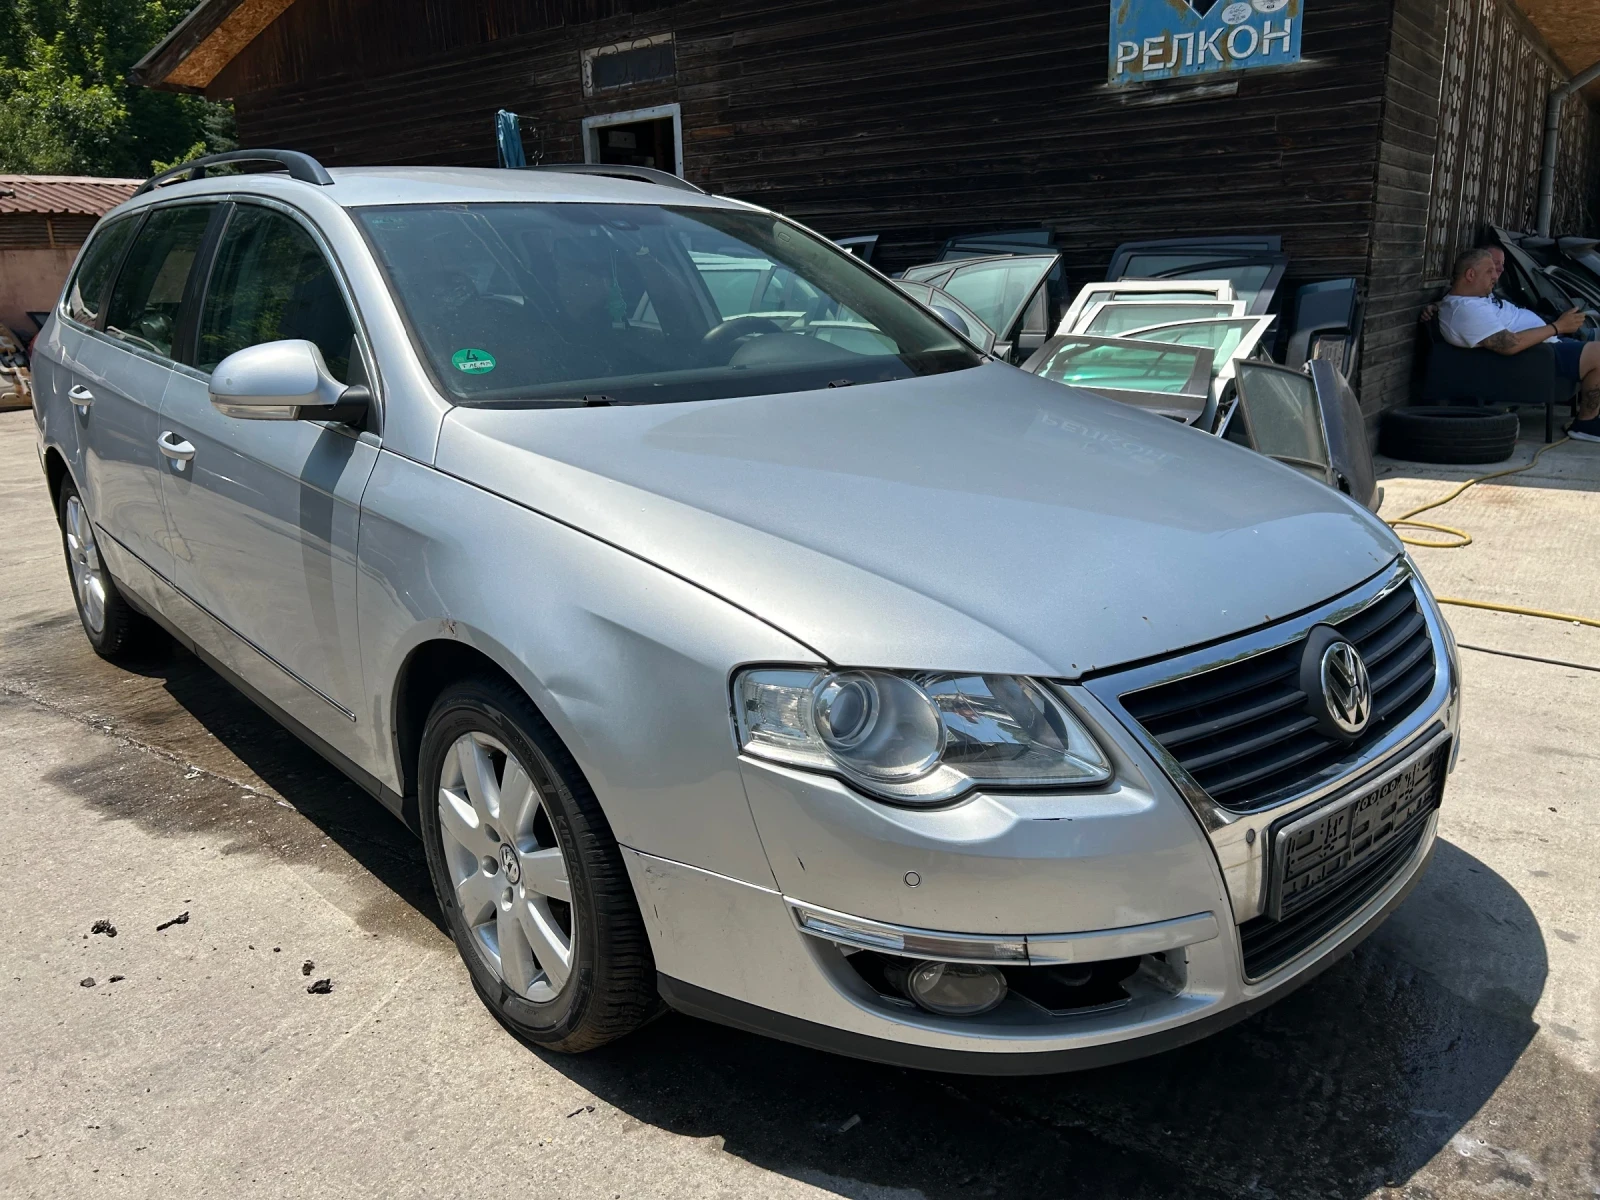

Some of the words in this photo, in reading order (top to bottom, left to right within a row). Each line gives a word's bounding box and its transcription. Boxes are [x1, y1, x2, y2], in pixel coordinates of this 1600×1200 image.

[1116, 18, 1291, 74] РЕЛКОН
[466, 349, 479, 361] 4
[556, 814, 586, 903] KINERGY
